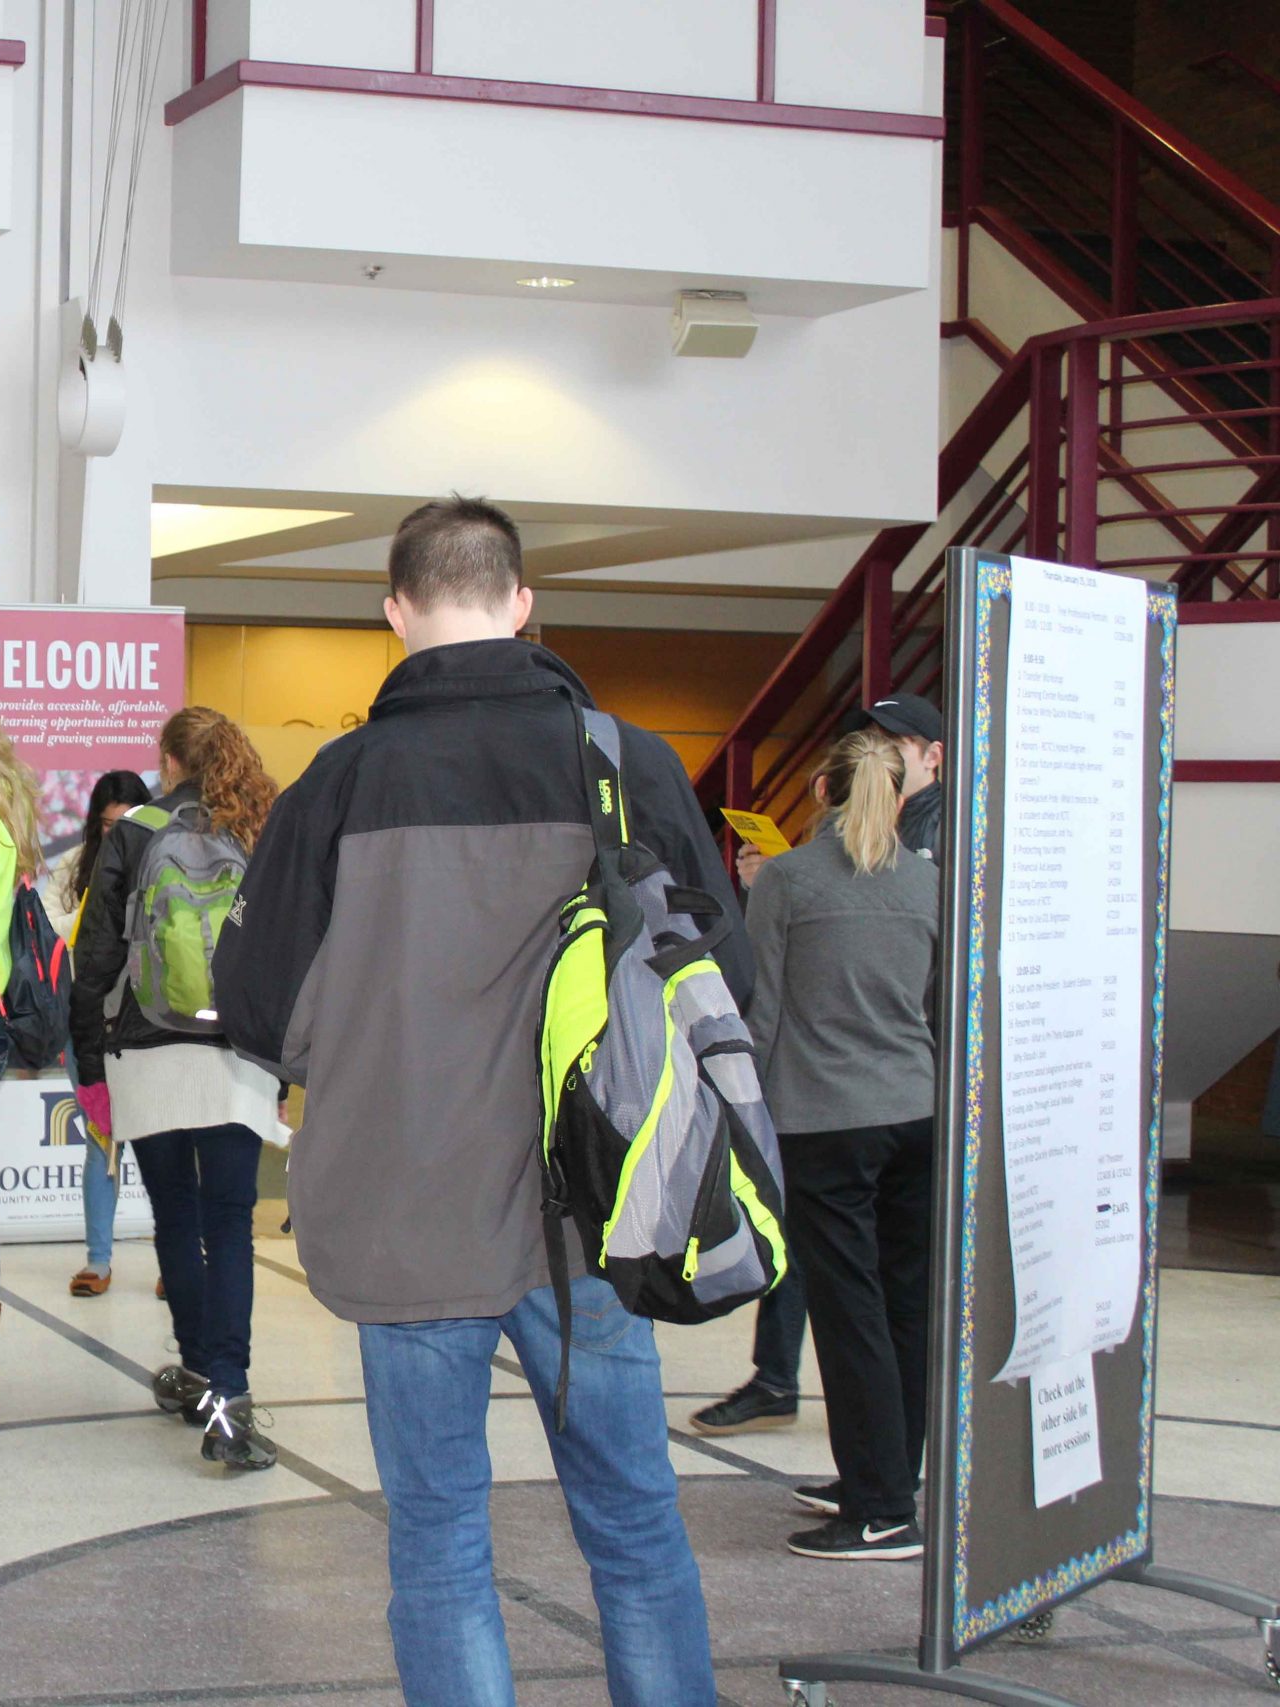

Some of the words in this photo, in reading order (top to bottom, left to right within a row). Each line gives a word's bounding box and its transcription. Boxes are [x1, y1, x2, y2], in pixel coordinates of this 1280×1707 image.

[48, 700, 104, 714] accessible,
[108, 701, 169, 715] affordable,
[0, 715, 47, 730] learning
[51, 716, 124, 732] opportunities
[127, 717, 138, 728] to
[23, 732, 45, 744] and
[48, 733, 93, 747] growing
[96, 734, 157, 747] community.
[35, 1193, 56, 1203] AND
[1038, 1382, 1063, 1406] Check
[1064, 1380, 1075, 1397] out
[1075, 1375, 1086, 1391] the
[1041, 1414, 1061, 1432] other
[1063, 1405, 1077, 1425] side
[1078, 1401, 1089, 1418] for
[1043, 1442, 1062, 1460] more
[1063, 1430, 1091, 1452] sessions
